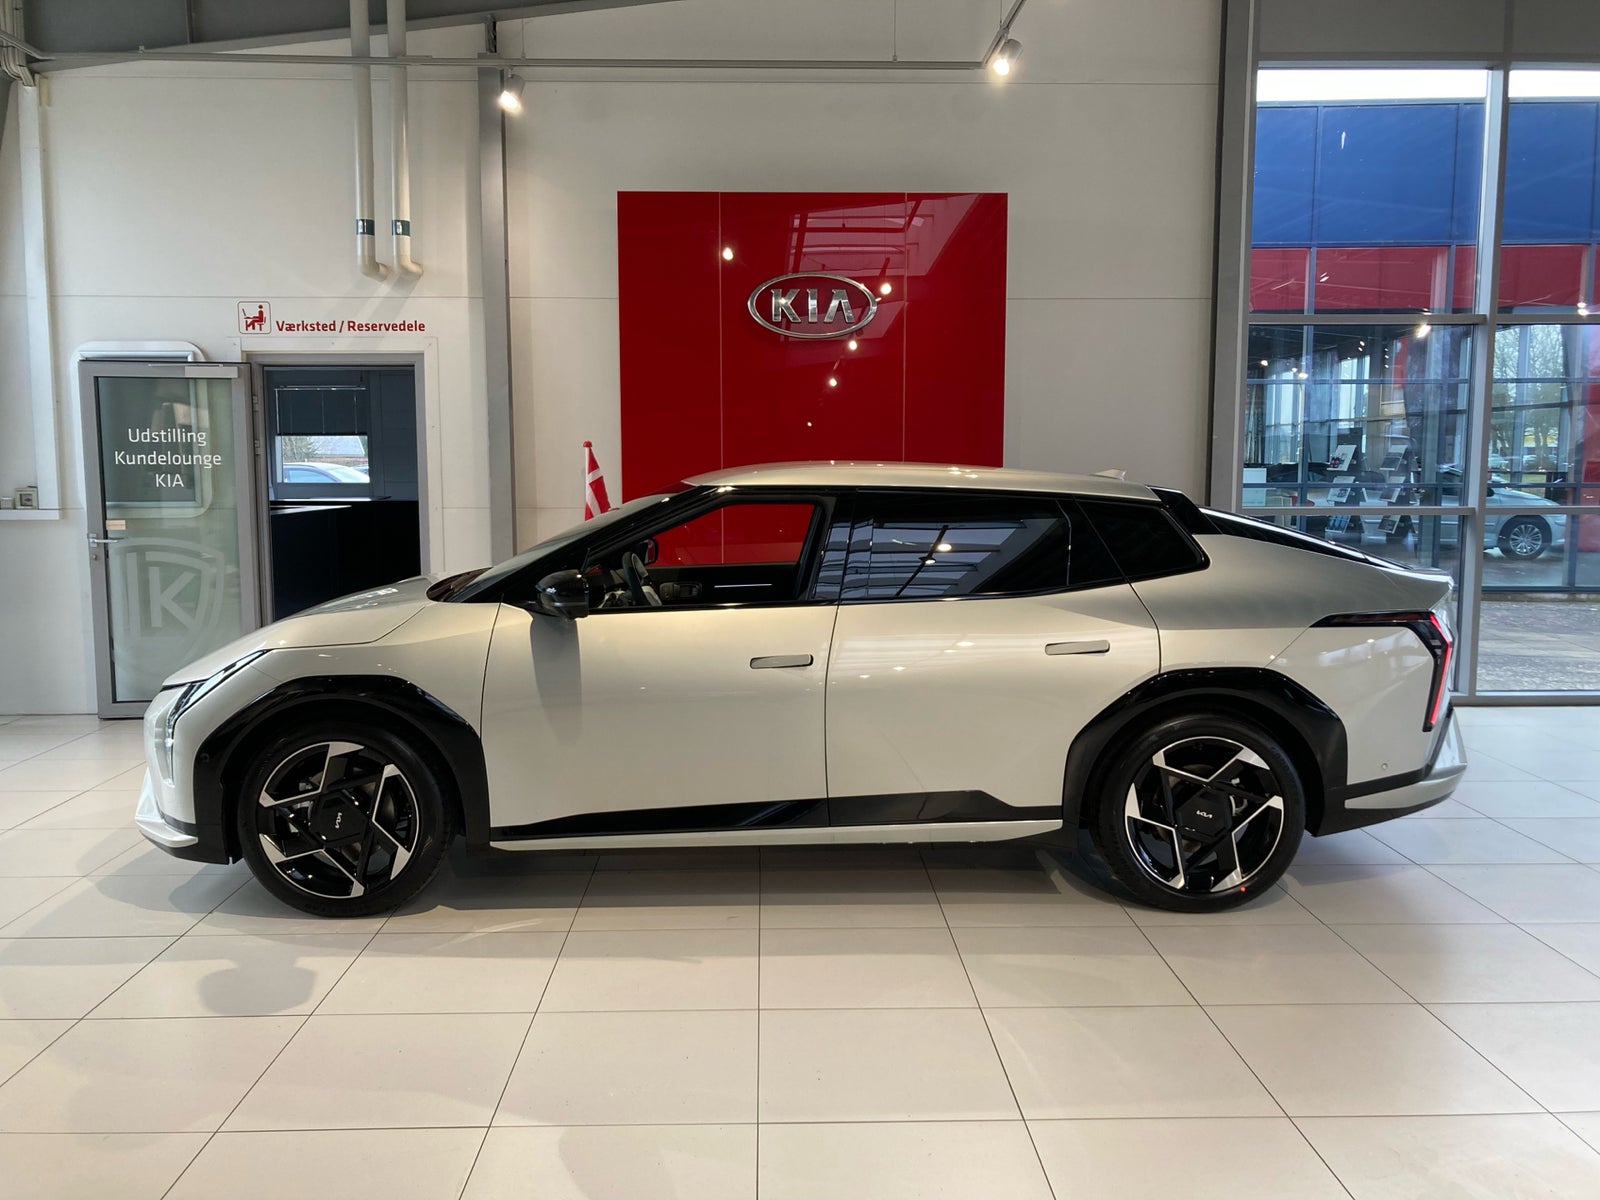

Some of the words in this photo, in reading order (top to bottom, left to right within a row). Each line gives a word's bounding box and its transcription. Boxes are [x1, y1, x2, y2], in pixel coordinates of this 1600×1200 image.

[771, 289, 855, 323] KIA
[275, 320, 336, 332] Værksted
[339, 320, 344, 333] /
[347, 320, 426, 332] Reservedele
[128, 428, 207, 447] Udstilling
[114, 450, 222, 469] Kundelounge
[155, 473, 185, 488] KIA
